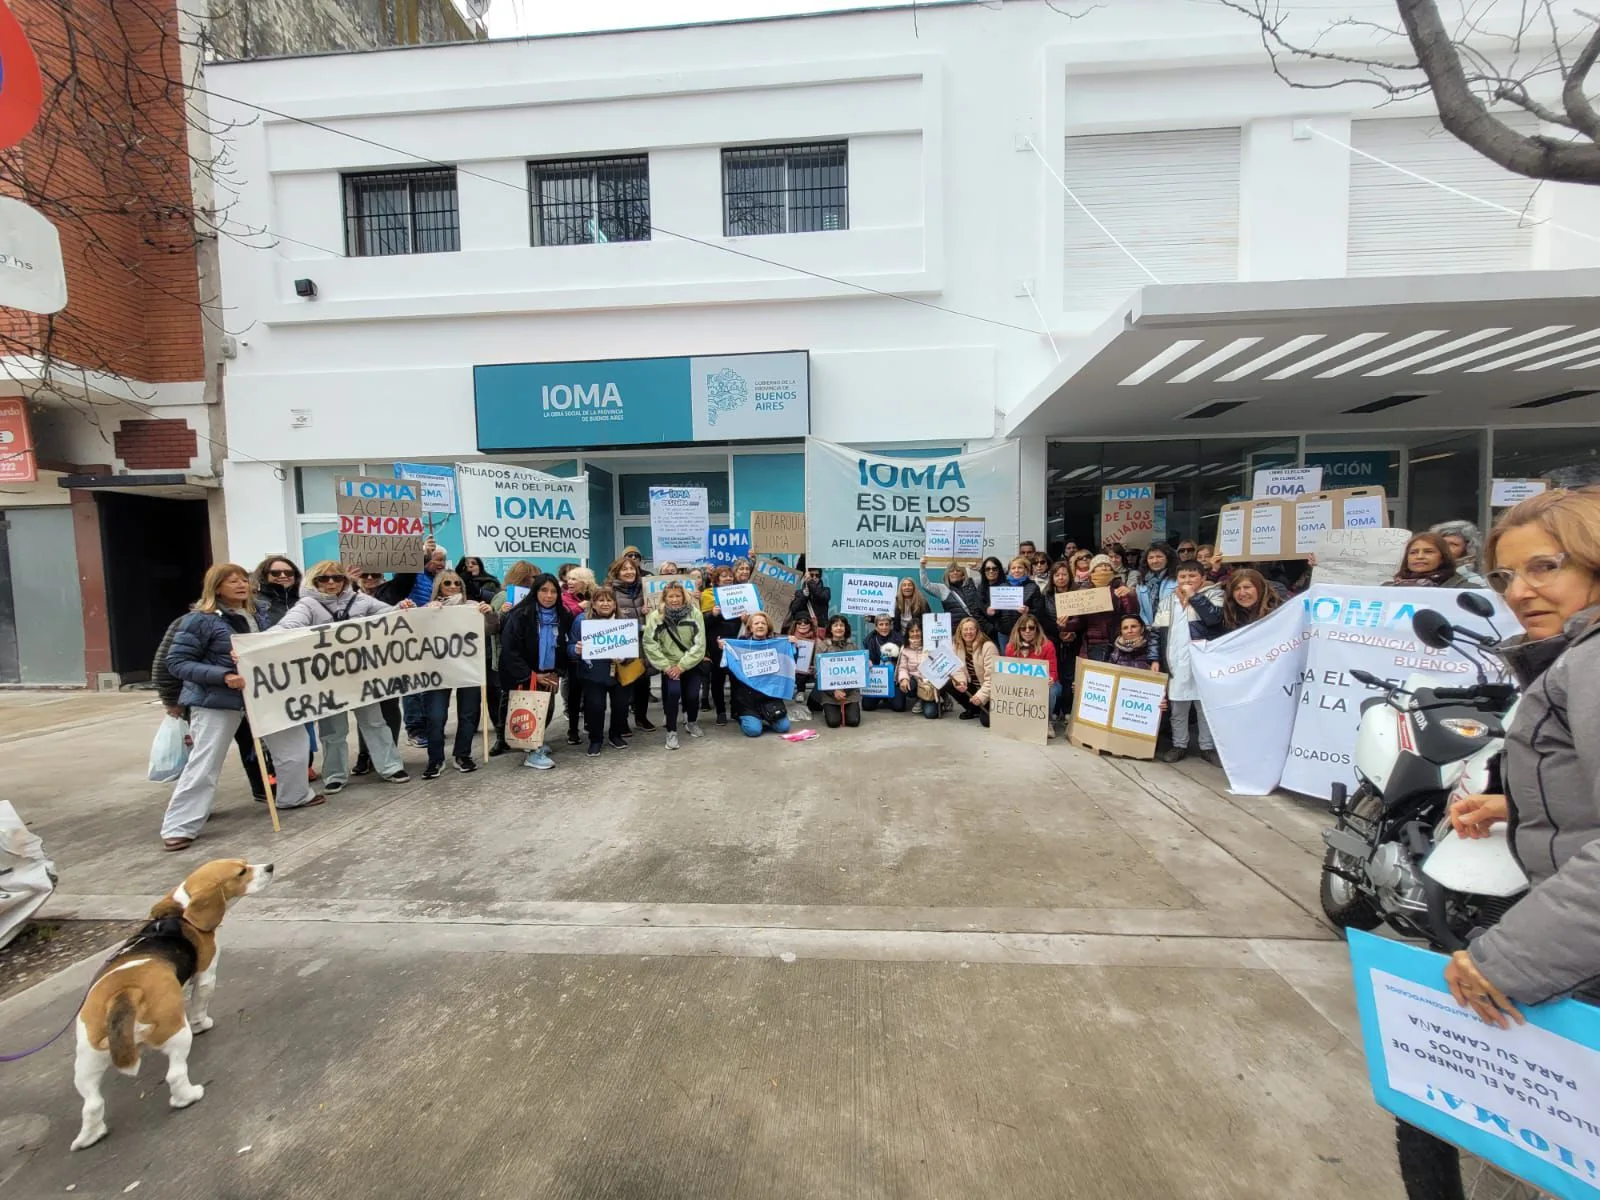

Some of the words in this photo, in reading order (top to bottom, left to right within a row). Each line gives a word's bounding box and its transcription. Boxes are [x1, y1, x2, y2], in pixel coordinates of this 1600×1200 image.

[542, 382, 624, 411] IOMA
[754, 391, 797, 401] BUENOS
[564, 409, 581, 417] SOCIAL
[597, 408, 624, 416] PROVINCIA
[755, 401, 785, 411] AIRES
[589, 414, 609, 422] BUENOS
[458, 466, 511, 480] AFILIADOS
[858, 458, 966, 490] IOMA
[345, 480, 416, 501] IOMA
[420, 489, 442, 498] OMA
[495, 481, 519, 491] MAR
[521, 482, 542, 492] DEL
[544, 484, 574, 493] PLATA
[1106, 487, 1152, 500] IOMA
[1266, 484, 1306, 496] IOMA
[494, 496, 576, 521] IOMA
[856, 493, 887, 512] ES
[892, 495, 921, 513] DE
[927, 495, 971, 514] LOS
[1118, 500, 1133, 511] ES
[1104, 513, 1120, 523] DE
[1125, 510, 1151, 521] LOS
[1347, 516, 1377, 527] IOMA
[339, 515, 423, 535] DEMORA
[1222, 528, 1241, 536] IOMA
[1253, 525, 1277, 534] IOMA
[1298, 522, 1327, 532] IOMA
[477, 525, 500, 538] NO
[504, 526, 591, 540] QUEREMOS
[339, 534, 422, 552] AUTORIZAR
[712, 533, 749, 547] IOMA
[831, 539, 890, 549] AFILIADOS
[929, 537, 950, 545] IOMA
[495, 541, 577, 554] VIOLENCIA
[709, 548, 738, 563] ROBA
[872, 551, 897, 561] MAR
[899, 551, 921, 561] DEL
[759, 561, 797, 586] IOMA
[847, 578, 894, 588] AUTARQUIA
[857, 588, 884, 597] IOMA
[726, 596, 749, 607] IOMA
[309, 615, 415, 651] IOMA
[592, 633, 628, 646] IOMA
[1228, 656, 1263, 675] OBRA
[1265, 639, 1302, 662] SOCIA
[1327, 630, 1417, 653] PROVINCIA
[252, 631, 480, 699] AUTOCONVOCADOS
[829, 665, 857, 676] IOMA
[998, 661, 1048, 678] IOMA
[1394, 655, 1470, 674] BUENOS
[1323, 670, 1351, 688] EL
[284, 688, 350, 722] GRAL
[359, 670, 443, 702] ALVARADO
[994, 685, 1036, 699] VULNERA
[1084, 691, 1107, 705] IOMA
[990, 699, 1047, 720] DERECHOS
[1121, 698, 1153, 713] IOMA
[1319, 694, 1347, 713] LA
[512, 714, 529, 724] OPEN
[1407, 1014, 1491, 1052] CAMPAÑA
[1391, 1037, 1410, 1053] DE
[1428, 1038, 1517, 1081] AFILIADOS
[1496, 1047, 1518, 1063] SU
[1414, 1048, 1476, 1079] DINERO
[1481, 1074, 1499, 1088] EL
[1525, 1059, 1578, 1090] PARA
[1522, 1077, 1559, 1101] LOS
[1504, 1086, 1540, 1109] USA
[1546, 1105, 1600, 1136] ILLOF
